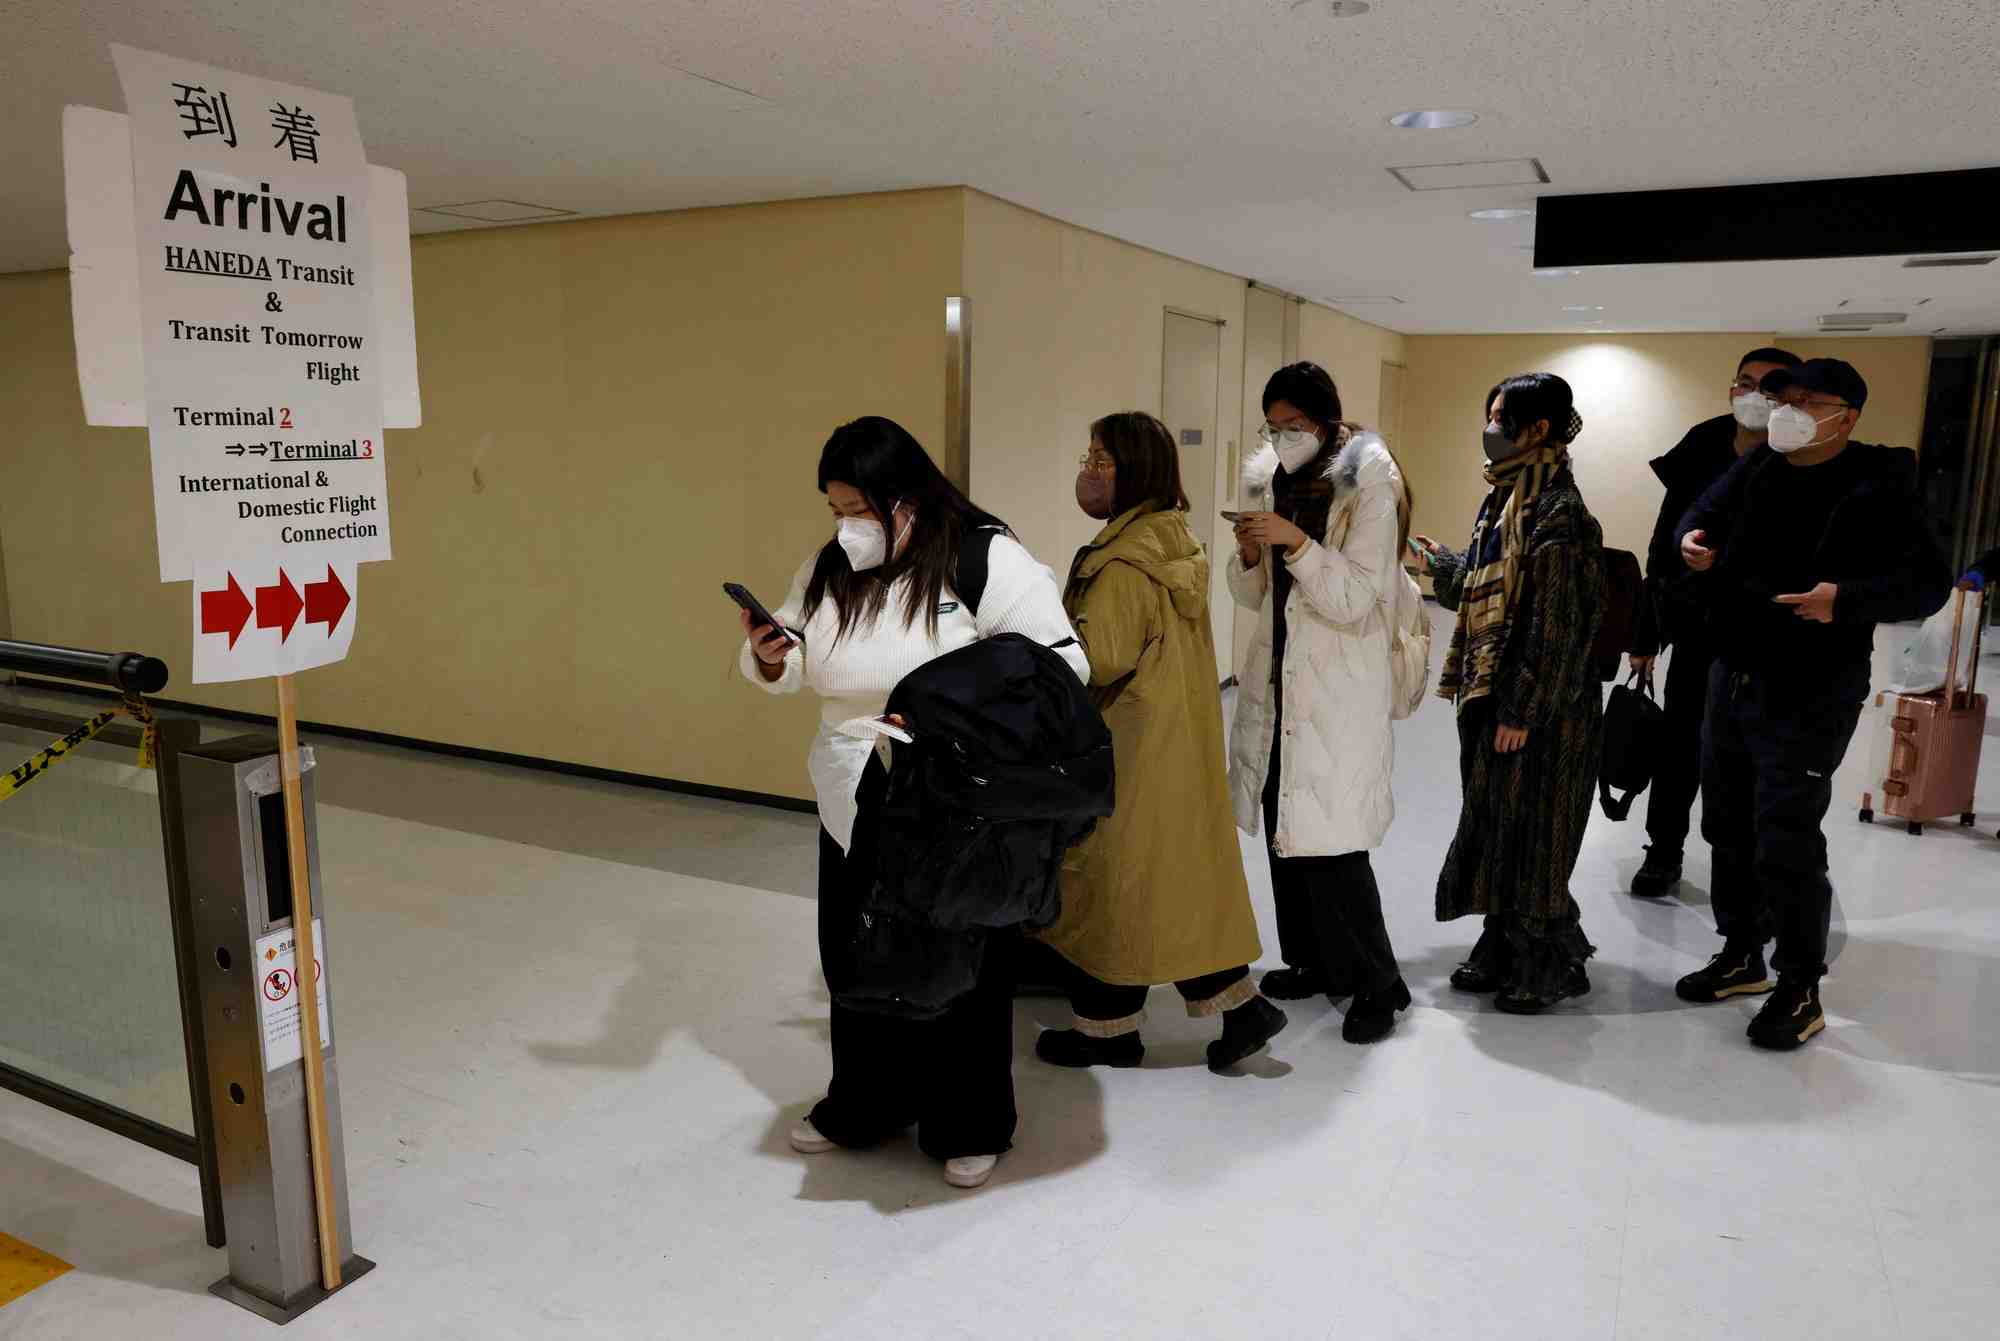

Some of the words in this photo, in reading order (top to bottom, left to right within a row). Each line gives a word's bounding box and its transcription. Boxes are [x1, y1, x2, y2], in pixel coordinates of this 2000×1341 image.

[172, 83, 320, 163] 到着
[164, 170, 346, 243] Arrival
[165, 246, 272, 281] HANEDA
[277, 259, 354, 286] Transit
[265, 292, 283, 312] &
[169, 320, 250, 343] Transit
[261, 326, 362, 349] Tomorrow
[307, 362, 360, 385] Flight
[174, 407, 274, 425] Terminal
[280, 408, 293, 428] 2
[270, 440, 357, 461] Terminal
[361, 440, 373, 459] 3
[180, 471, 309, 492] International
[316, 471, 328, 486] &
[238, 498, 324, 518] Domestic
[330, 495, 376, 516] Flight
[282, 522, 377, 543] Connection
